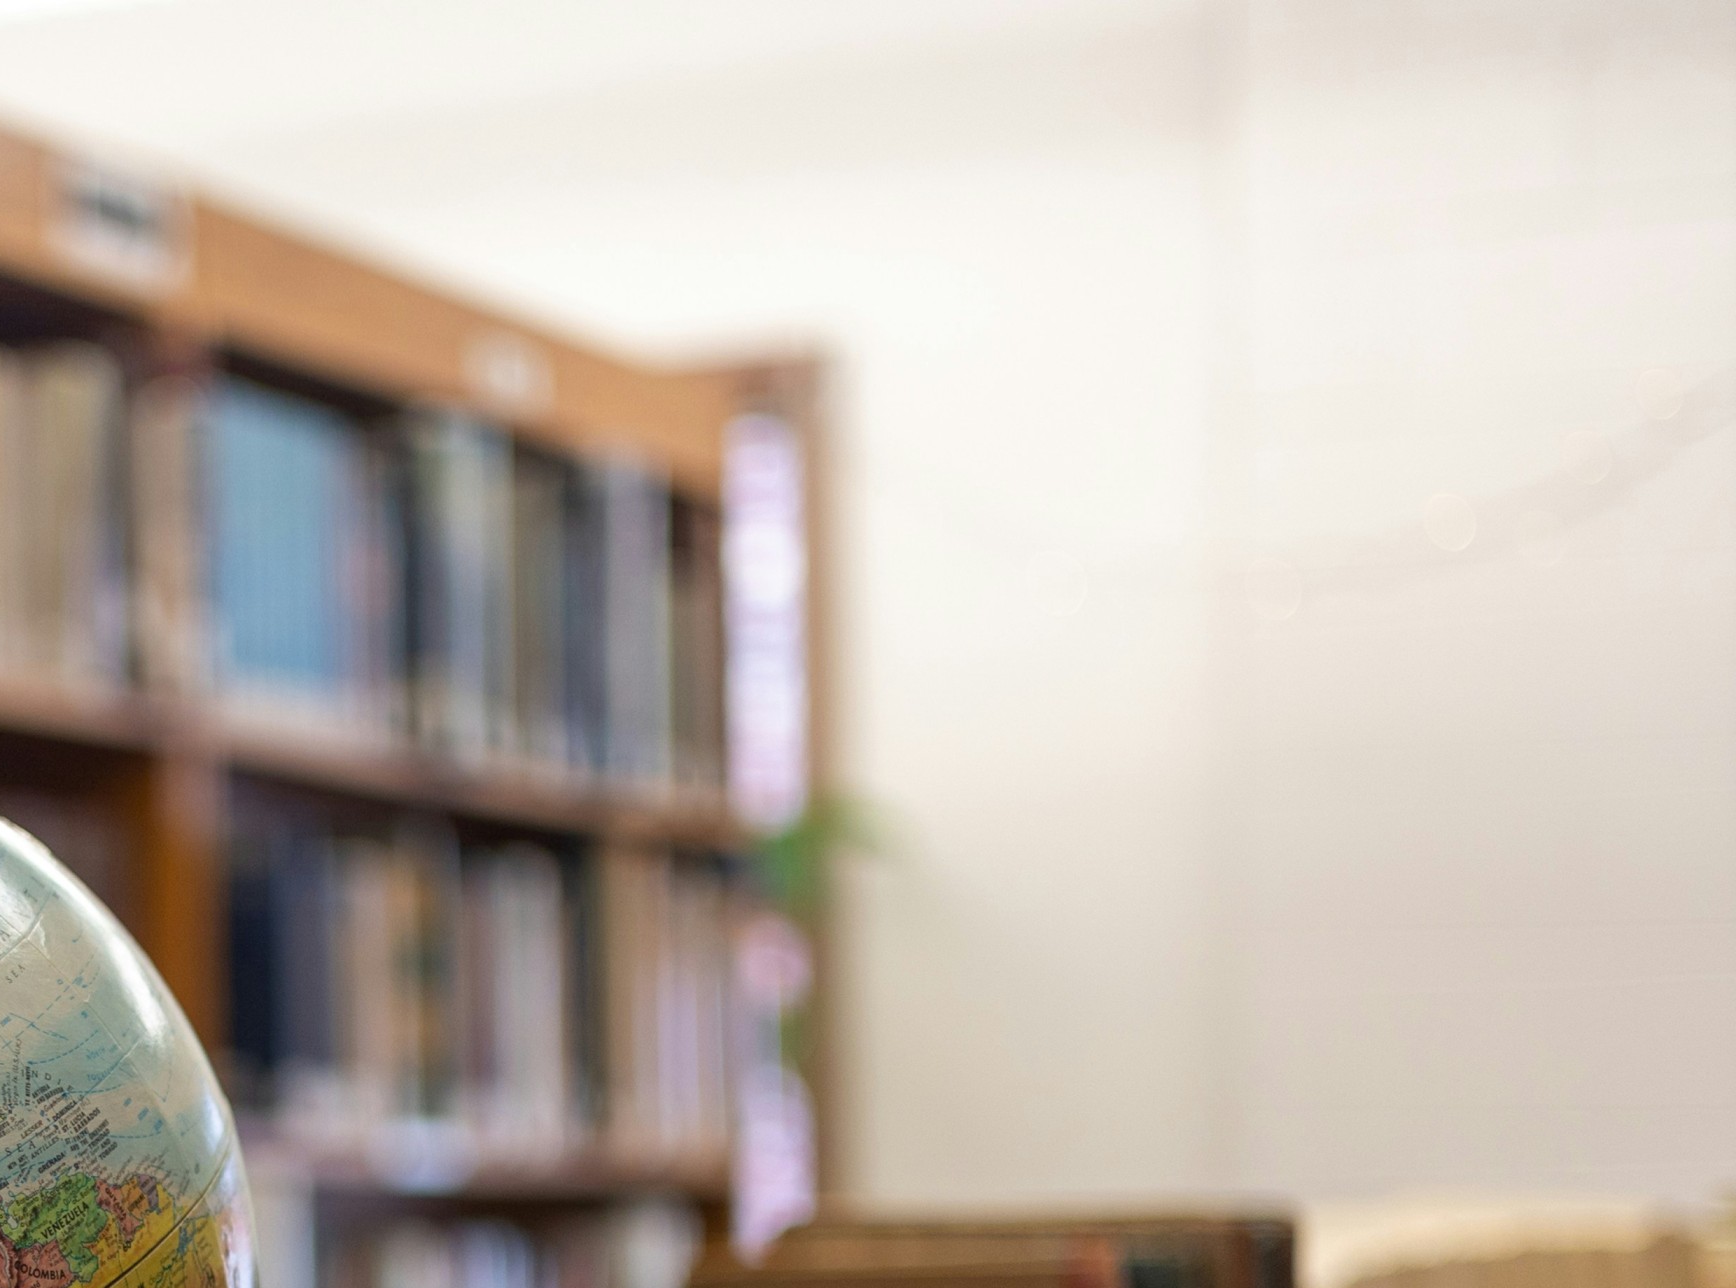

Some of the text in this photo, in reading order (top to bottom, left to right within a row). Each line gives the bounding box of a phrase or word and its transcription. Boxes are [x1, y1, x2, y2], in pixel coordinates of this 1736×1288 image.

[5, 964, 26, 984] SEA
[20, 1120, 43, 1139] LESSER
[6, 1140, 36, 1157] SEA
[38, 1153, 66, 1174] GRENADA
[40, 1201, 90, 1239] VENEZUELA
[15, 1261, 65, 1280] COLOMBIA
